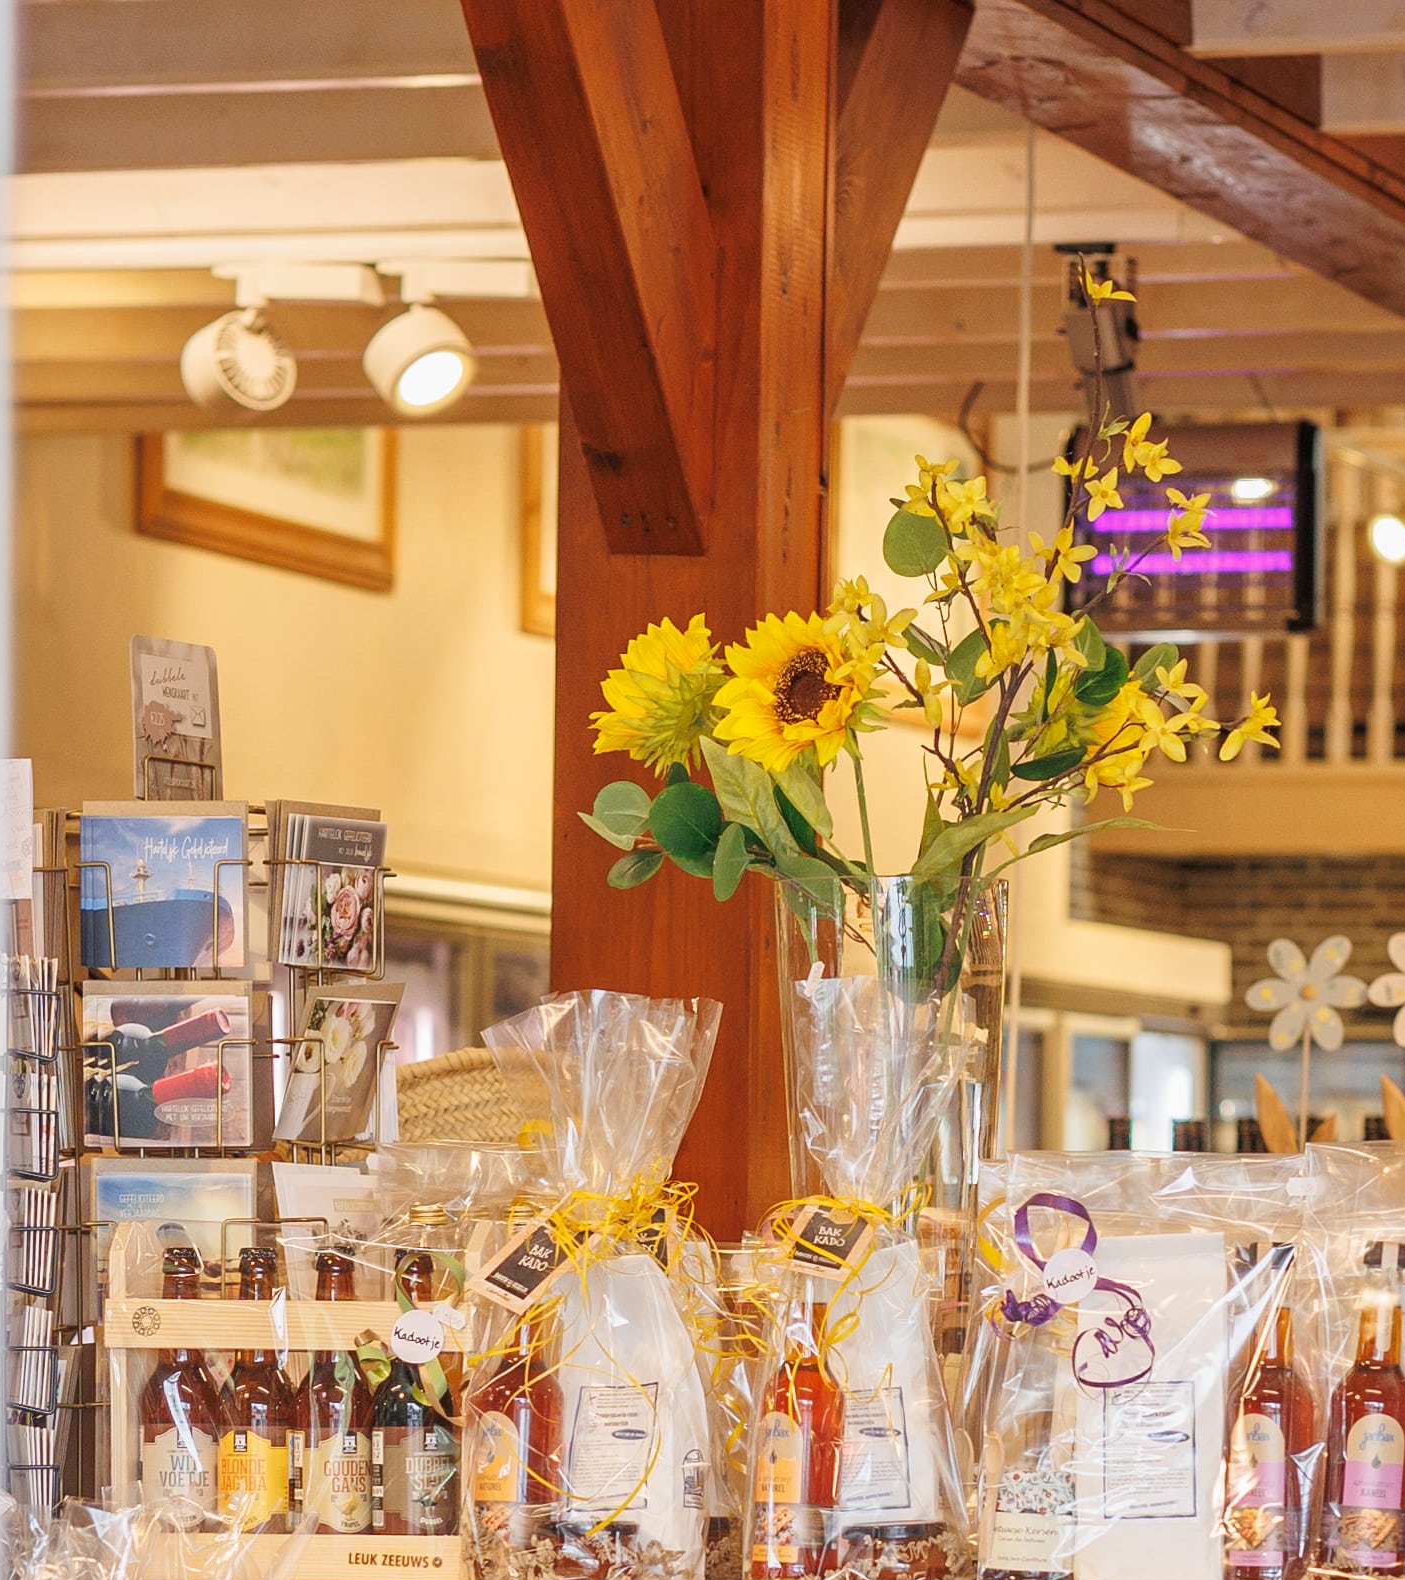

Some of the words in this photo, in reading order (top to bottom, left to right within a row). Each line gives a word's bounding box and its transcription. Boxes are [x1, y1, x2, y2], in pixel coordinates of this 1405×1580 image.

[144, 836, 180, 863] Hartelijk
[181, 835, 229, 858] Gefeliciteerd
[818, 1226, 843, 1237] BAK
[813, 1234, 846, 1247] KADO
[529, 1244, 554, 1259] BAK
[518, 1255, 549, 1272] KADO
[1046, 1264, 1096, 1289] Kadootje
[394, 1325, 440, 1349] Kadootje
[220, 1458, 266, 1475] BLONDE
[323, 1459, 373, 1477] GOUDEN
[159, 1471, 210, 1488] VOETJE
[220, 1475, 267, 1492] JACOBA
[331, 1477, 367, 1493] GANS
[348, 1552, 377, 1566] LEUK
[381, 1554, 429, 1568] ZEEUWS
